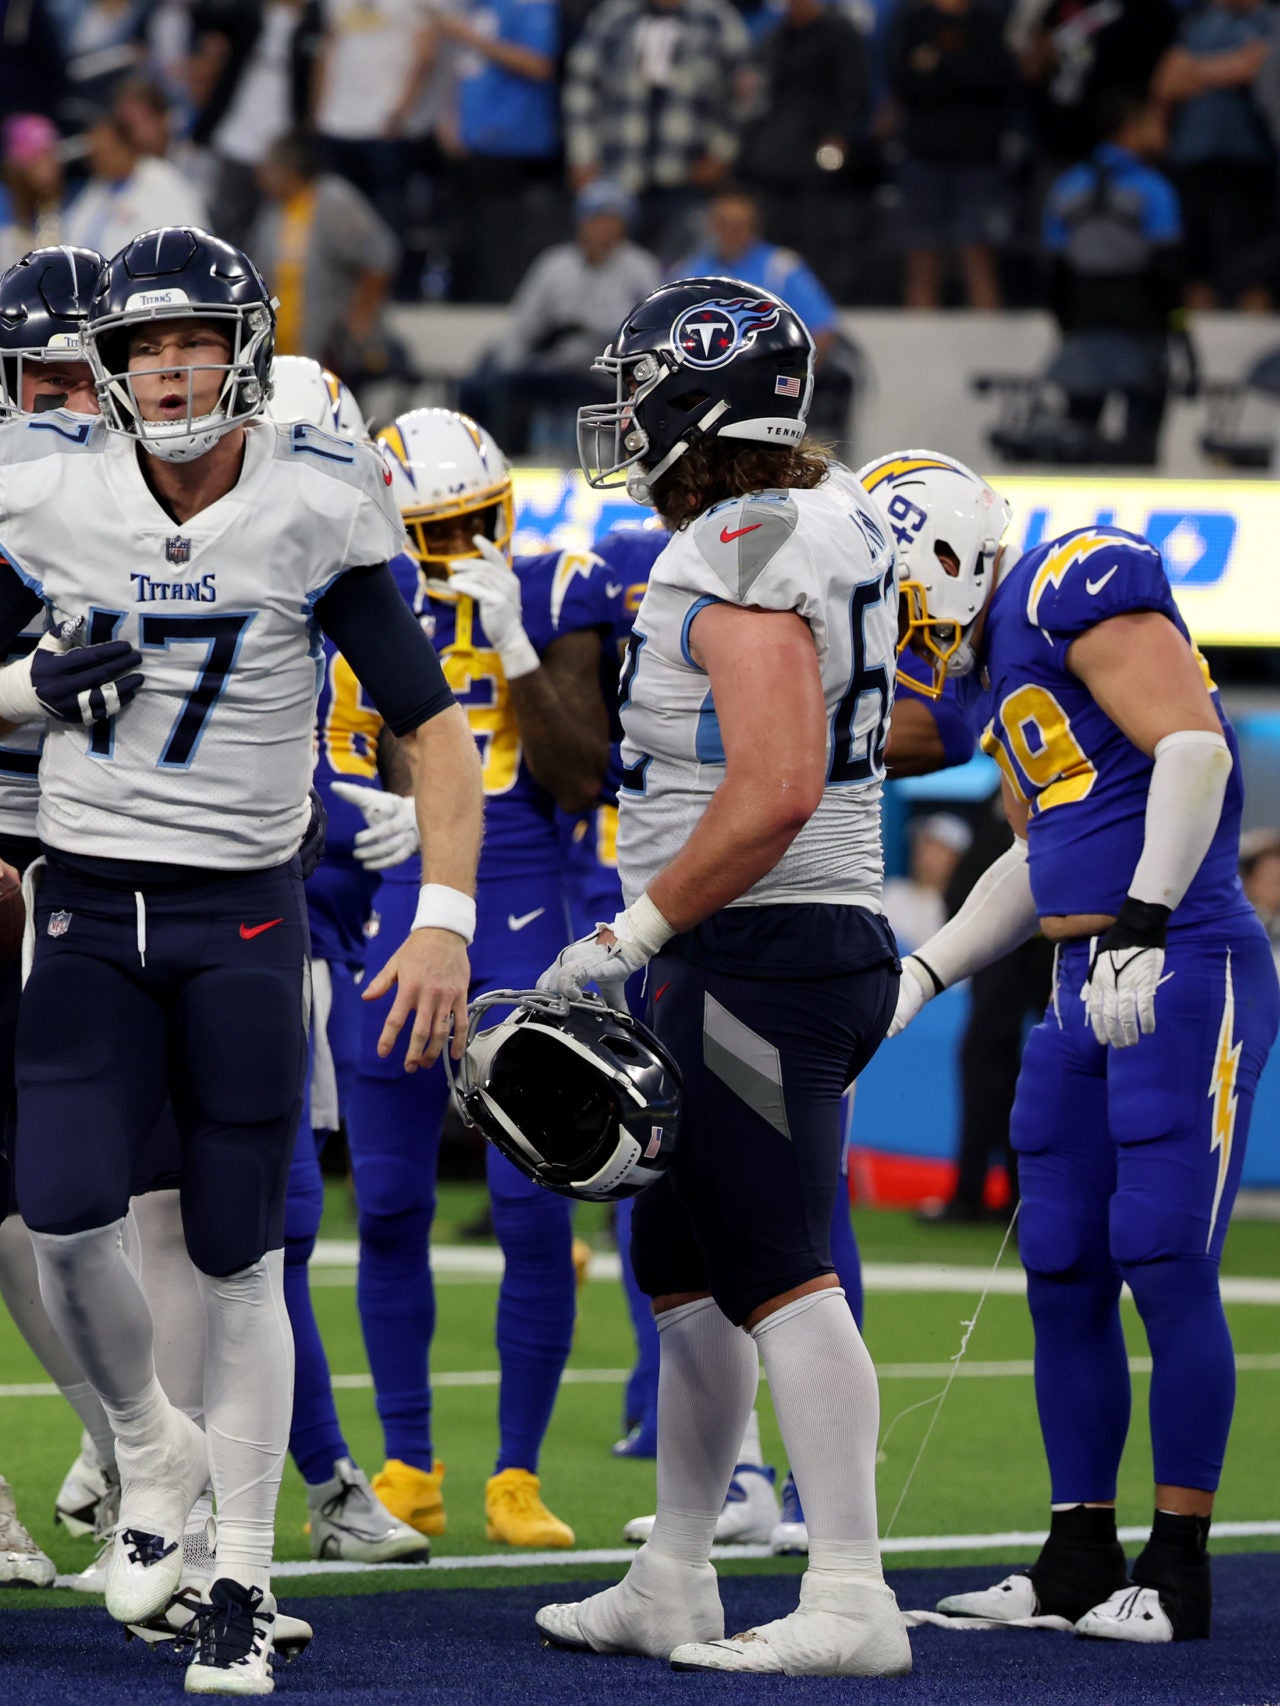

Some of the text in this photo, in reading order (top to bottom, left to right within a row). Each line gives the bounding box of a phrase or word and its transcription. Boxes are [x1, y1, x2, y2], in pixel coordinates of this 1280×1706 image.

[140, 291, 172, 306] TITANS
[685, 322, 729, 359] T
[767, 426, 803, 440] TENNE
[888, 494, 928, 546] 49
[130, 572, 217, 603] TITANS
[85, 605, 260, 770] 17
